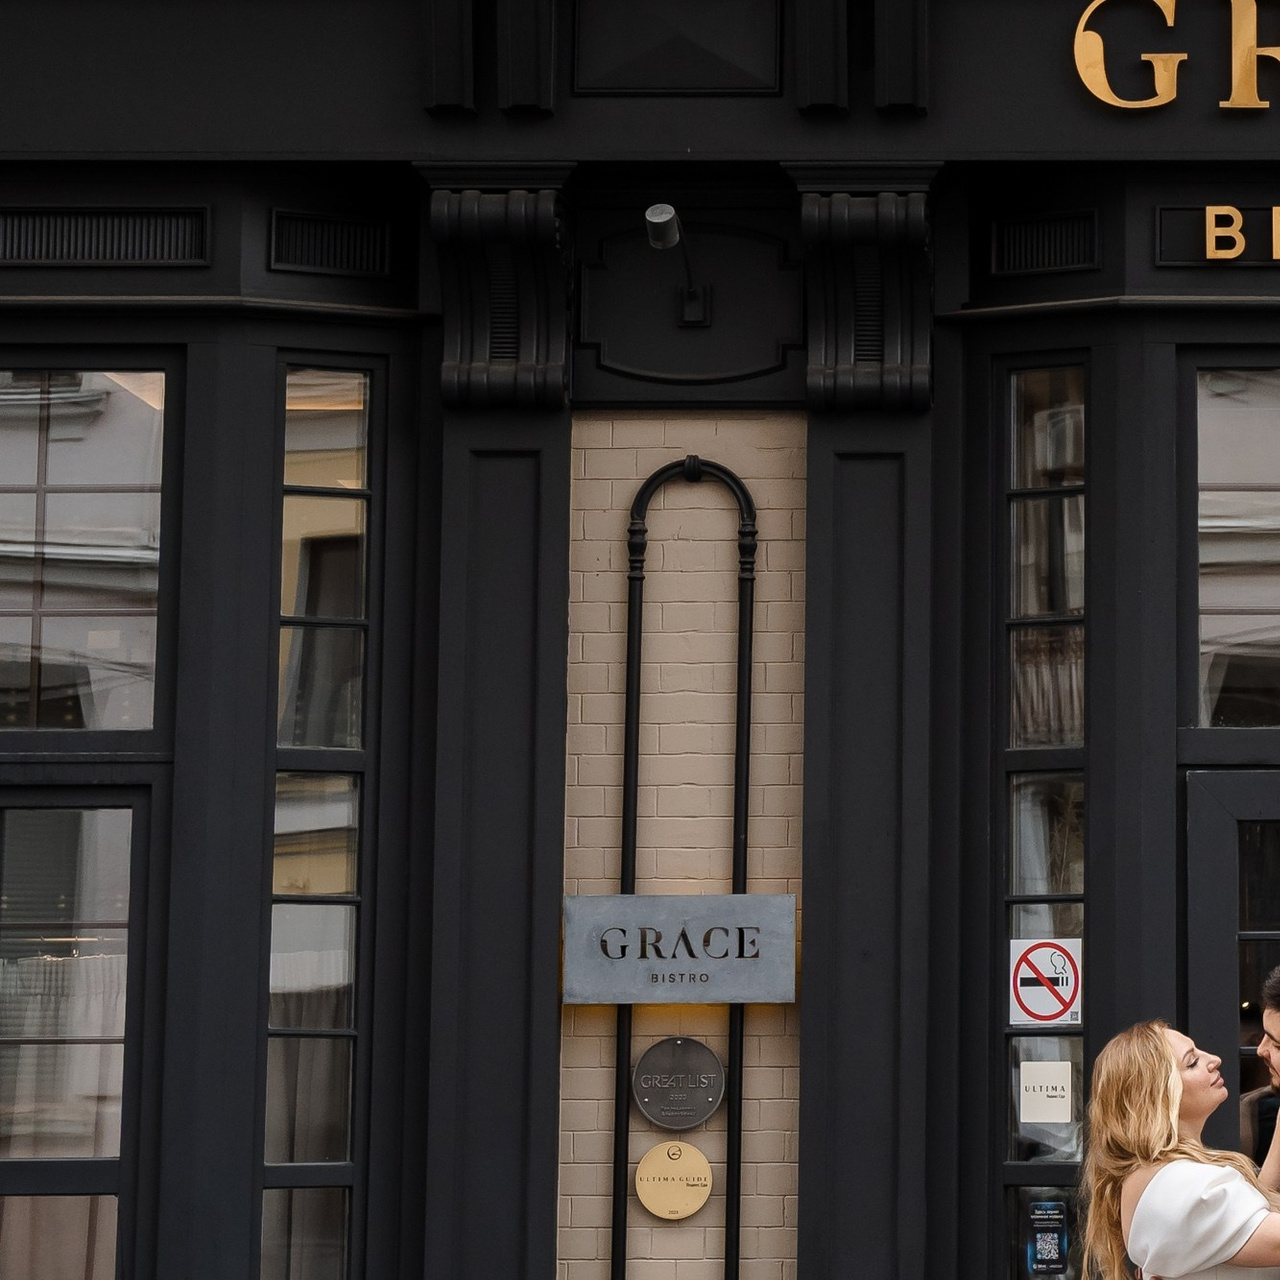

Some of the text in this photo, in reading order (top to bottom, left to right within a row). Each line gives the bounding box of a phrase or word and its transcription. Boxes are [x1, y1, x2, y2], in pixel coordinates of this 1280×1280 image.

[600, 927, 760, 959] GRACE
[651, 973, 709, 983] BISTRO
[640, 1074, 716, 1087] GREAT LIST
